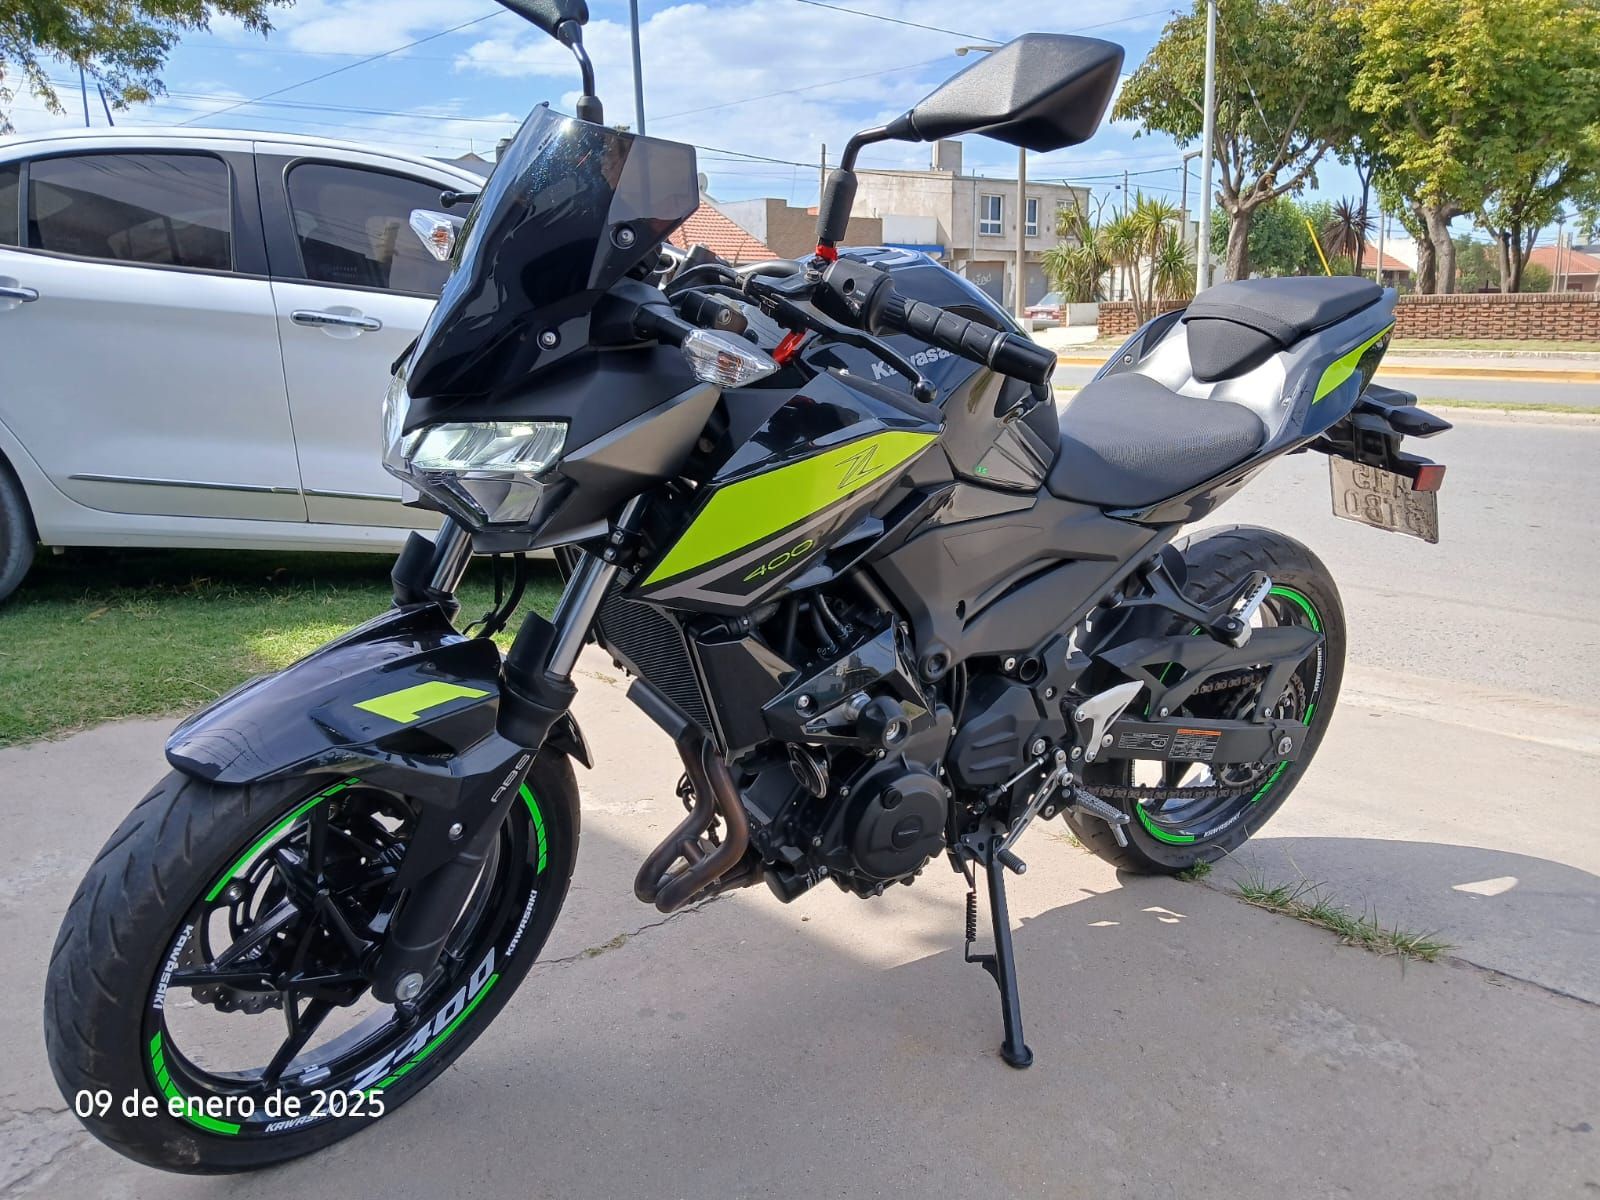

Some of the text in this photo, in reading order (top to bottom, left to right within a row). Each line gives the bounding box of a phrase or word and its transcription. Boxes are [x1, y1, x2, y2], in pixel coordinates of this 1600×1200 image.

[871, 347, 955, 380] Kasa
[834, 443, 885, 490] Z
[743, 539, 816, 582] 400
[490, 753, 531, 803] ABS
[505, 889, 538, 957] KAWASAKI
[152, 924, 194, 1010] KAWASAKI
[348, 946, 495, 1096] Z400
